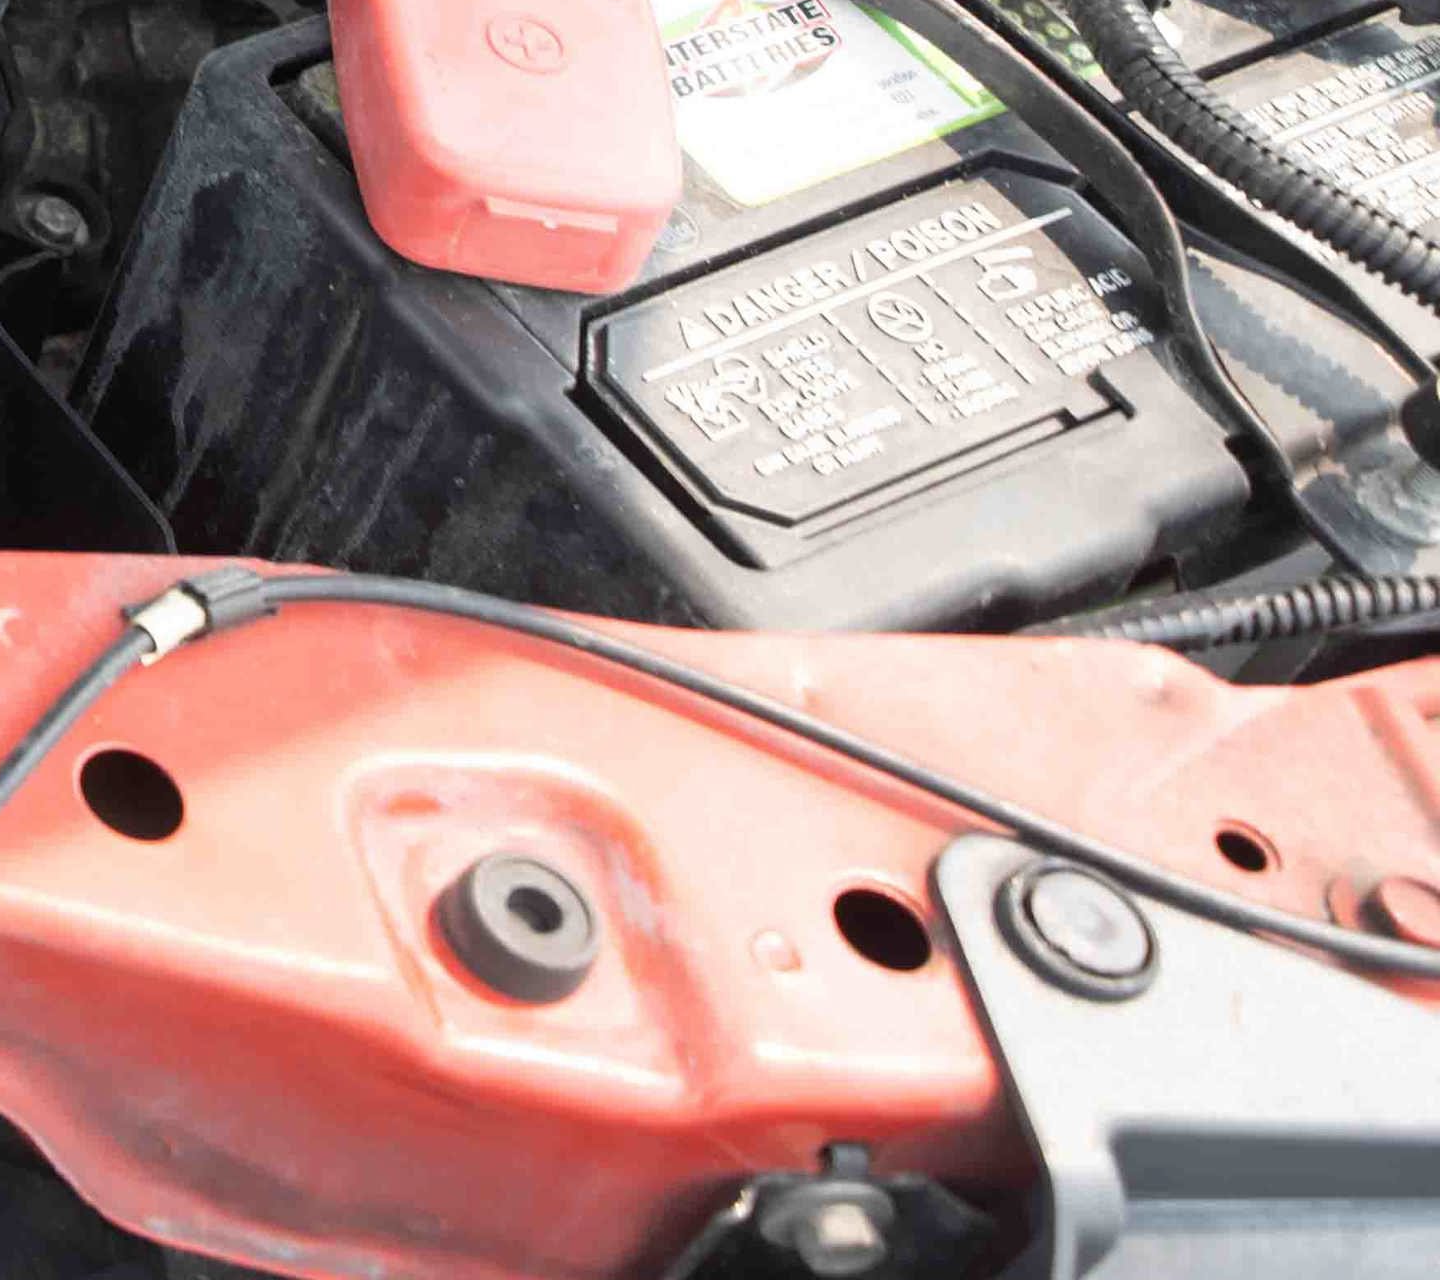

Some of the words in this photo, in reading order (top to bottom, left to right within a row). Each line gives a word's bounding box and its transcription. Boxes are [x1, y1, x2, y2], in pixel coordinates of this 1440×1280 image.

[703, 261, 855, 337] DANGER
[865, 201, 1003, 270] POISON
[1088, 267, 1133, 297] ACID
